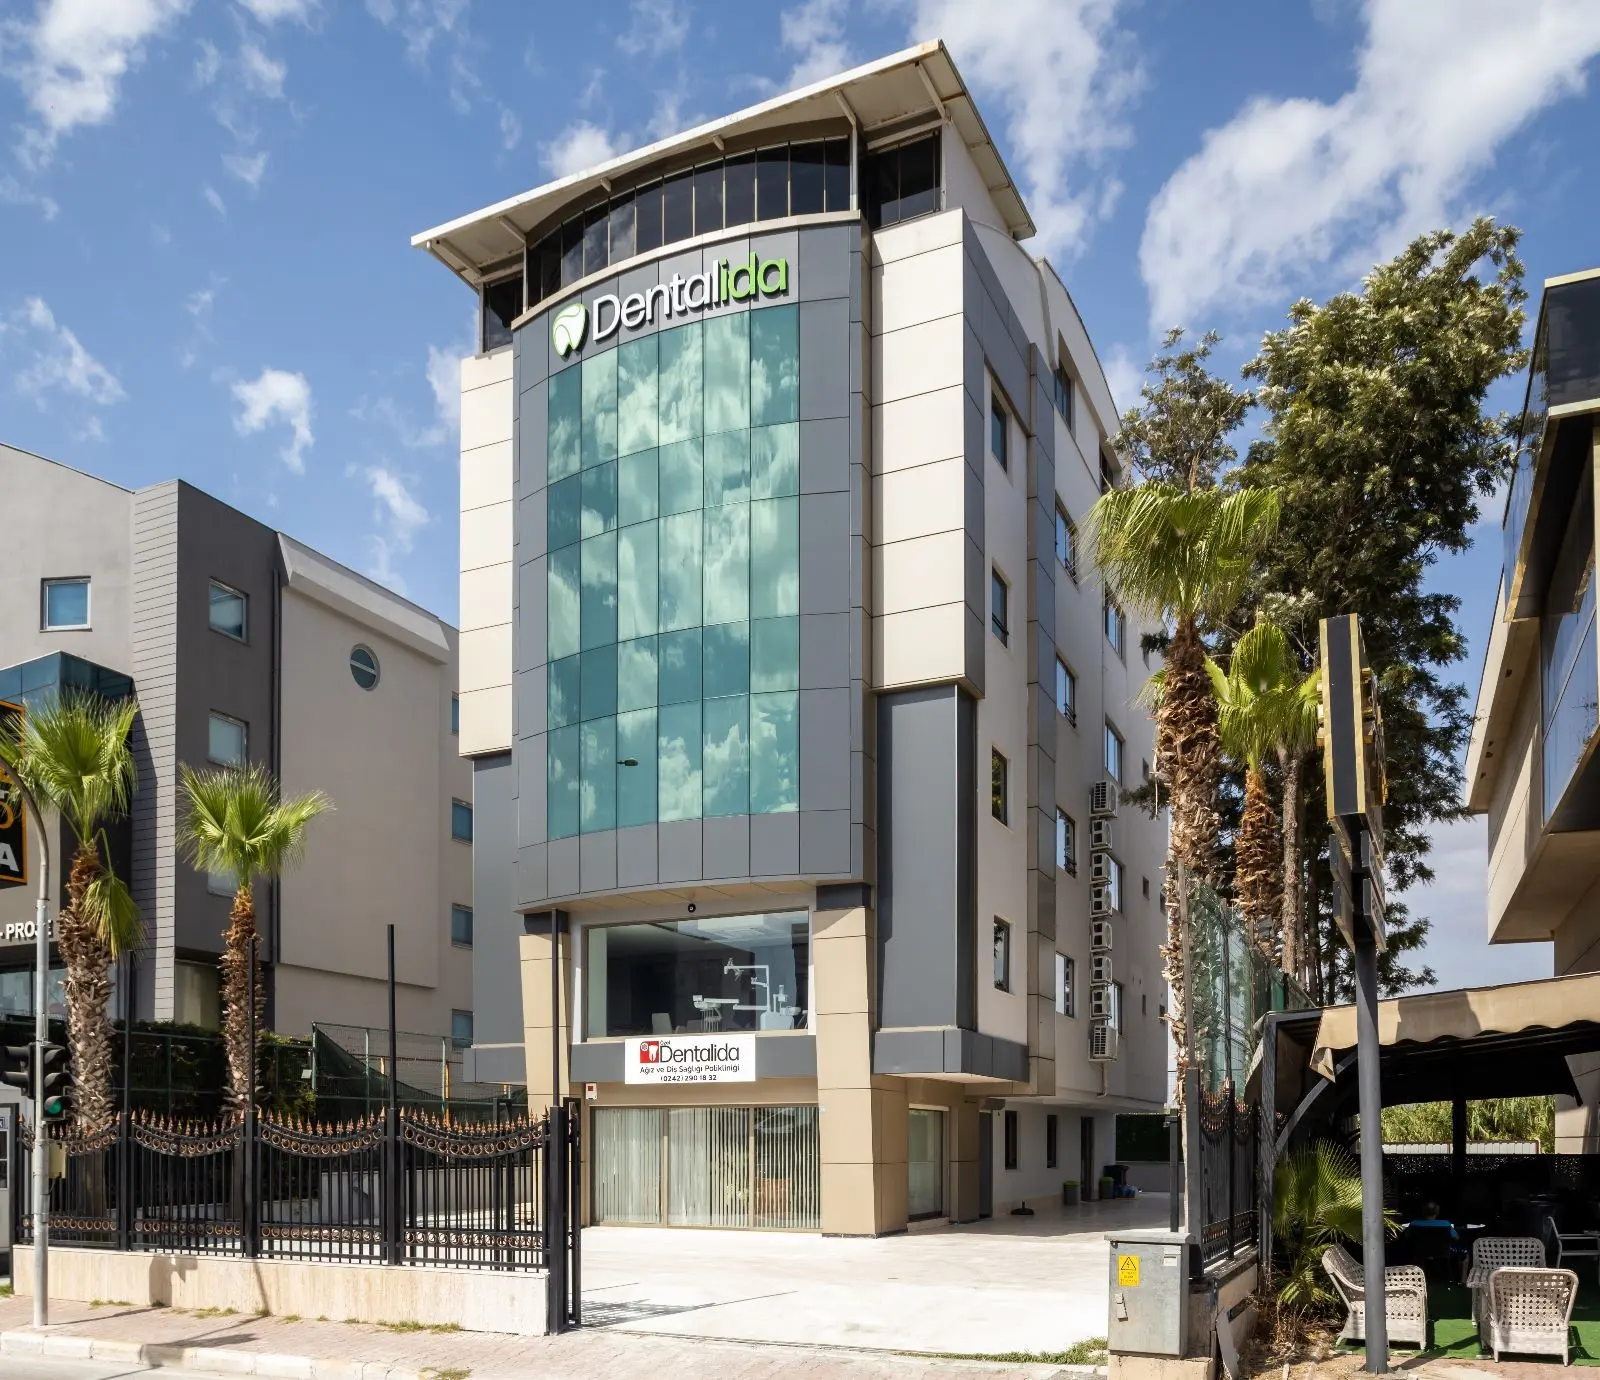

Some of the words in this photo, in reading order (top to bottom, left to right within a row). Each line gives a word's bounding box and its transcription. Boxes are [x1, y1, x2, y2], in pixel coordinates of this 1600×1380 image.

[592, 251, 789, 342] Dentalida
[6, 919, 53, 940] PRO
[660, 1043, 740, 1063] Dentalida
[640, 1066, 655, 1075] Ağız
[705, 1063, 740, 1073] Polikliniği
